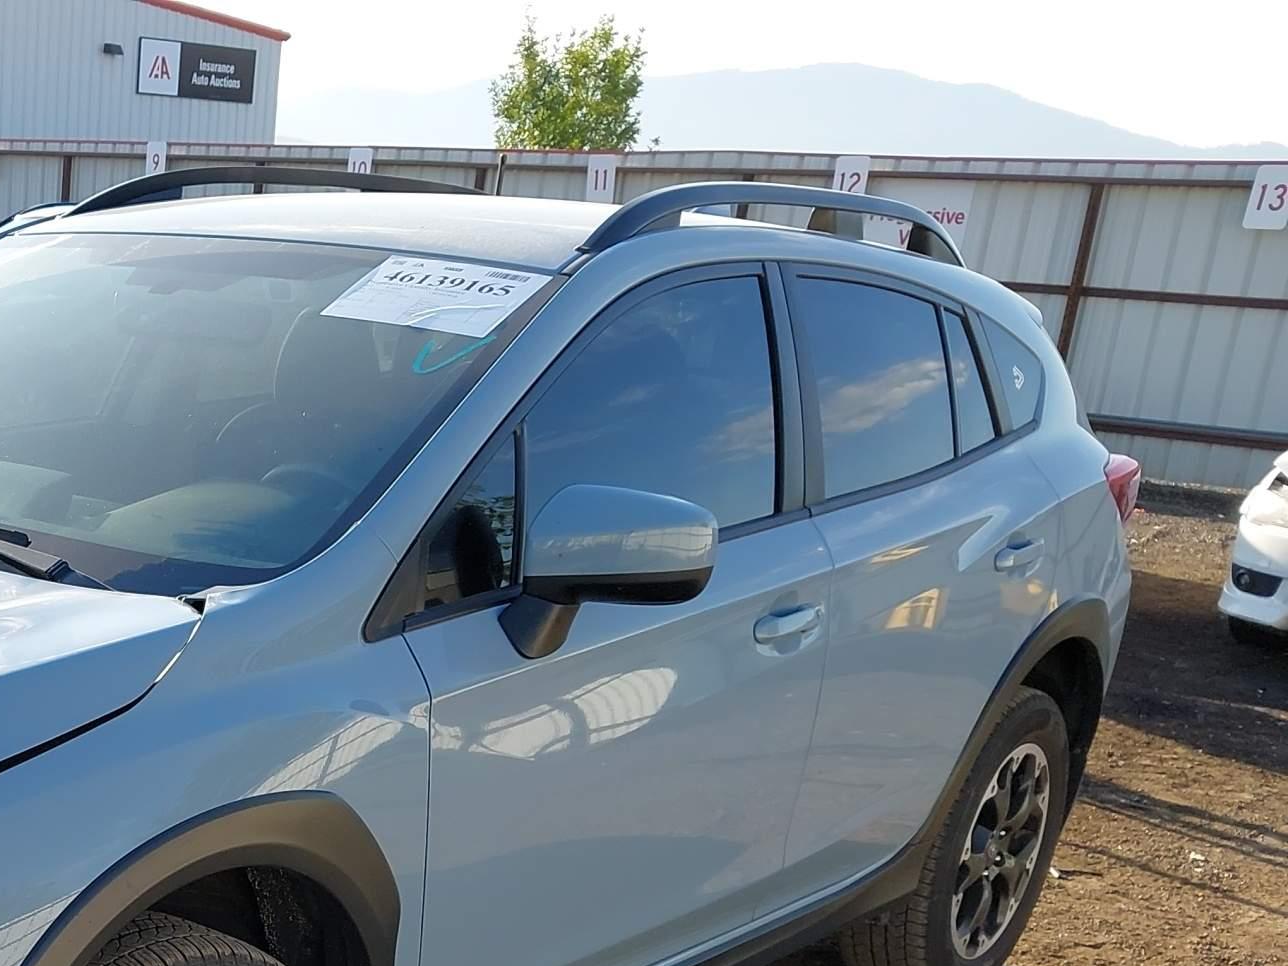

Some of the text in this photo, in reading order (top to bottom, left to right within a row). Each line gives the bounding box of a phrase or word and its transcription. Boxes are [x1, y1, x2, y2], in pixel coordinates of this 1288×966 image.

[199, 58, 235, 74] Insurance
[192, 72, 241, 89] Auto Auctions
[152, 153, 160, 170] 9
[593, 168, 608, 191] 11
[839, 171, 861, 193] 12
[1256, 183, 1288, 211] 13
[384, 270, 515, 297] 46139165
